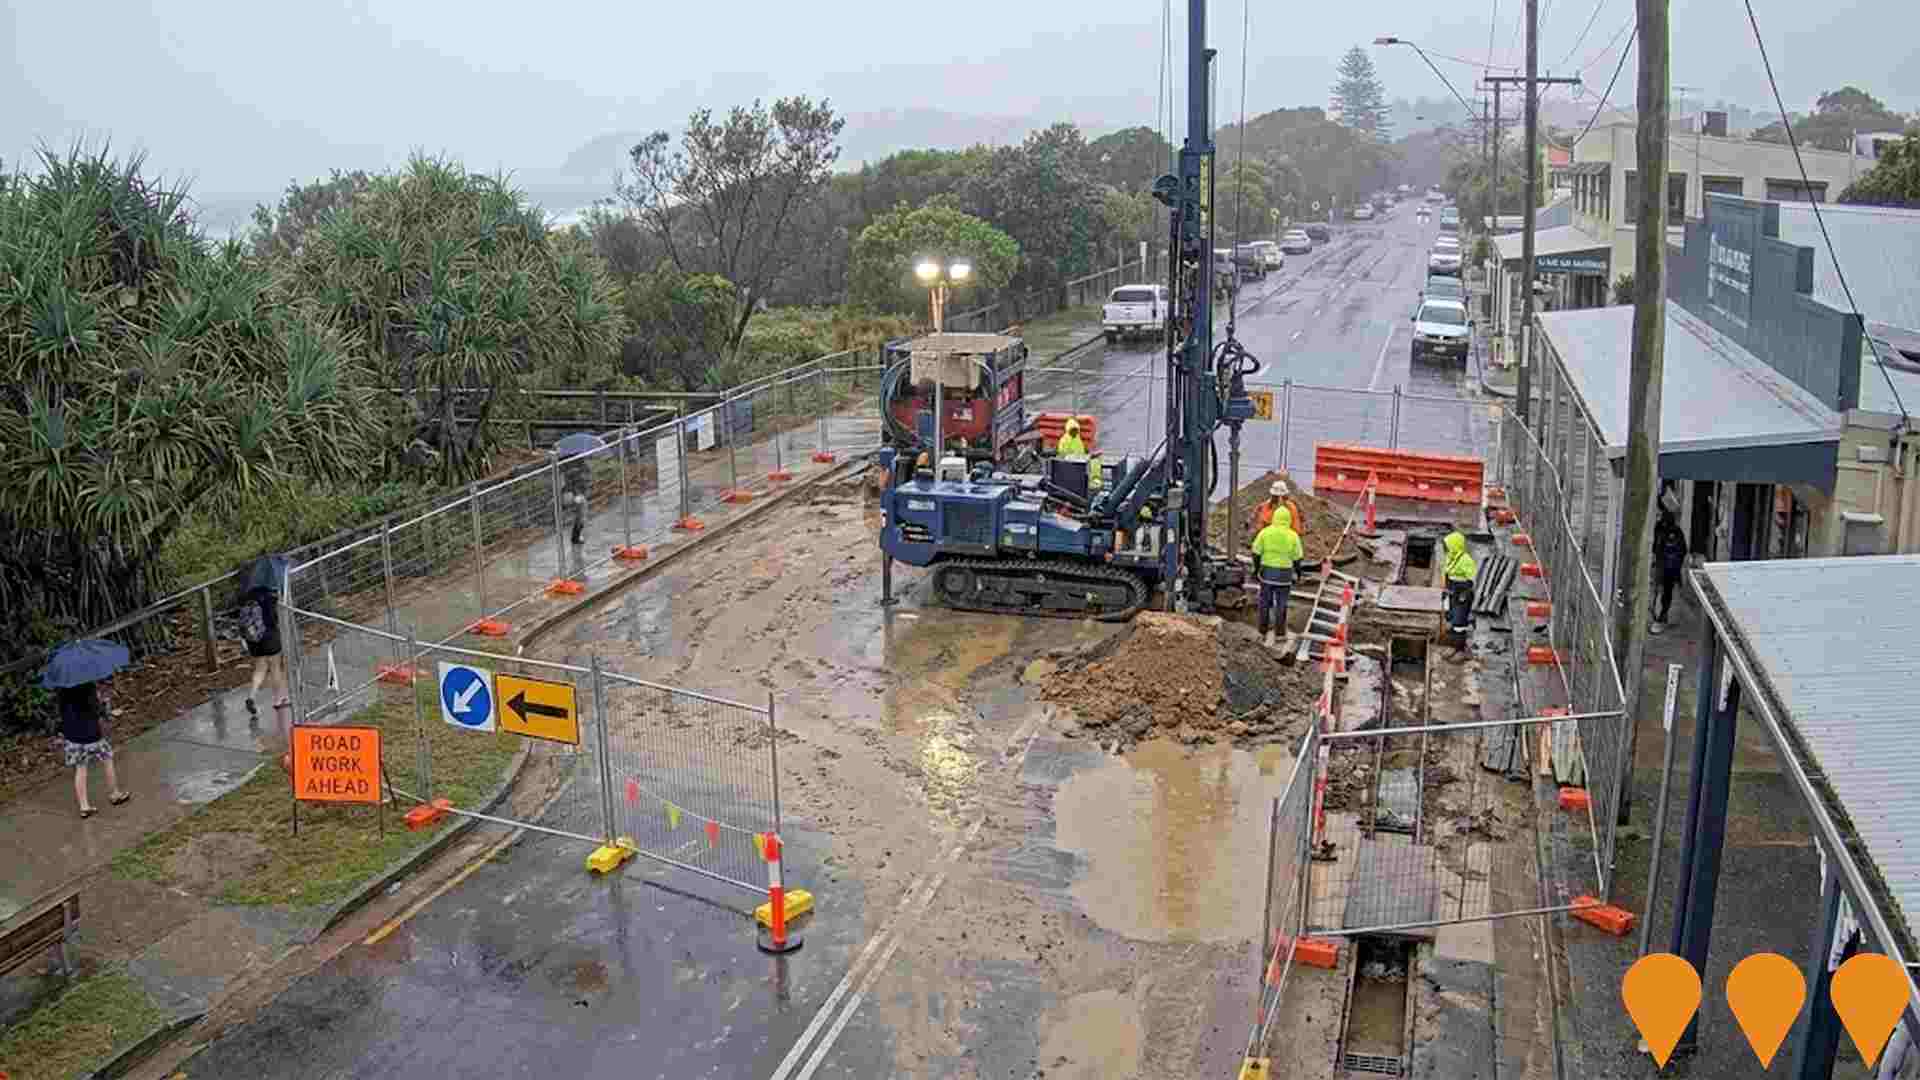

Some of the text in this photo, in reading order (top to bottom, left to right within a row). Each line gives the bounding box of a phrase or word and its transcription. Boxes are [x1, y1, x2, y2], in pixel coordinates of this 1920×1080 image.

[310, 735, 361, 751] ROAD
[310, 756, 361, 772] WORK
[306, 778, 369, 794] AHEAD
